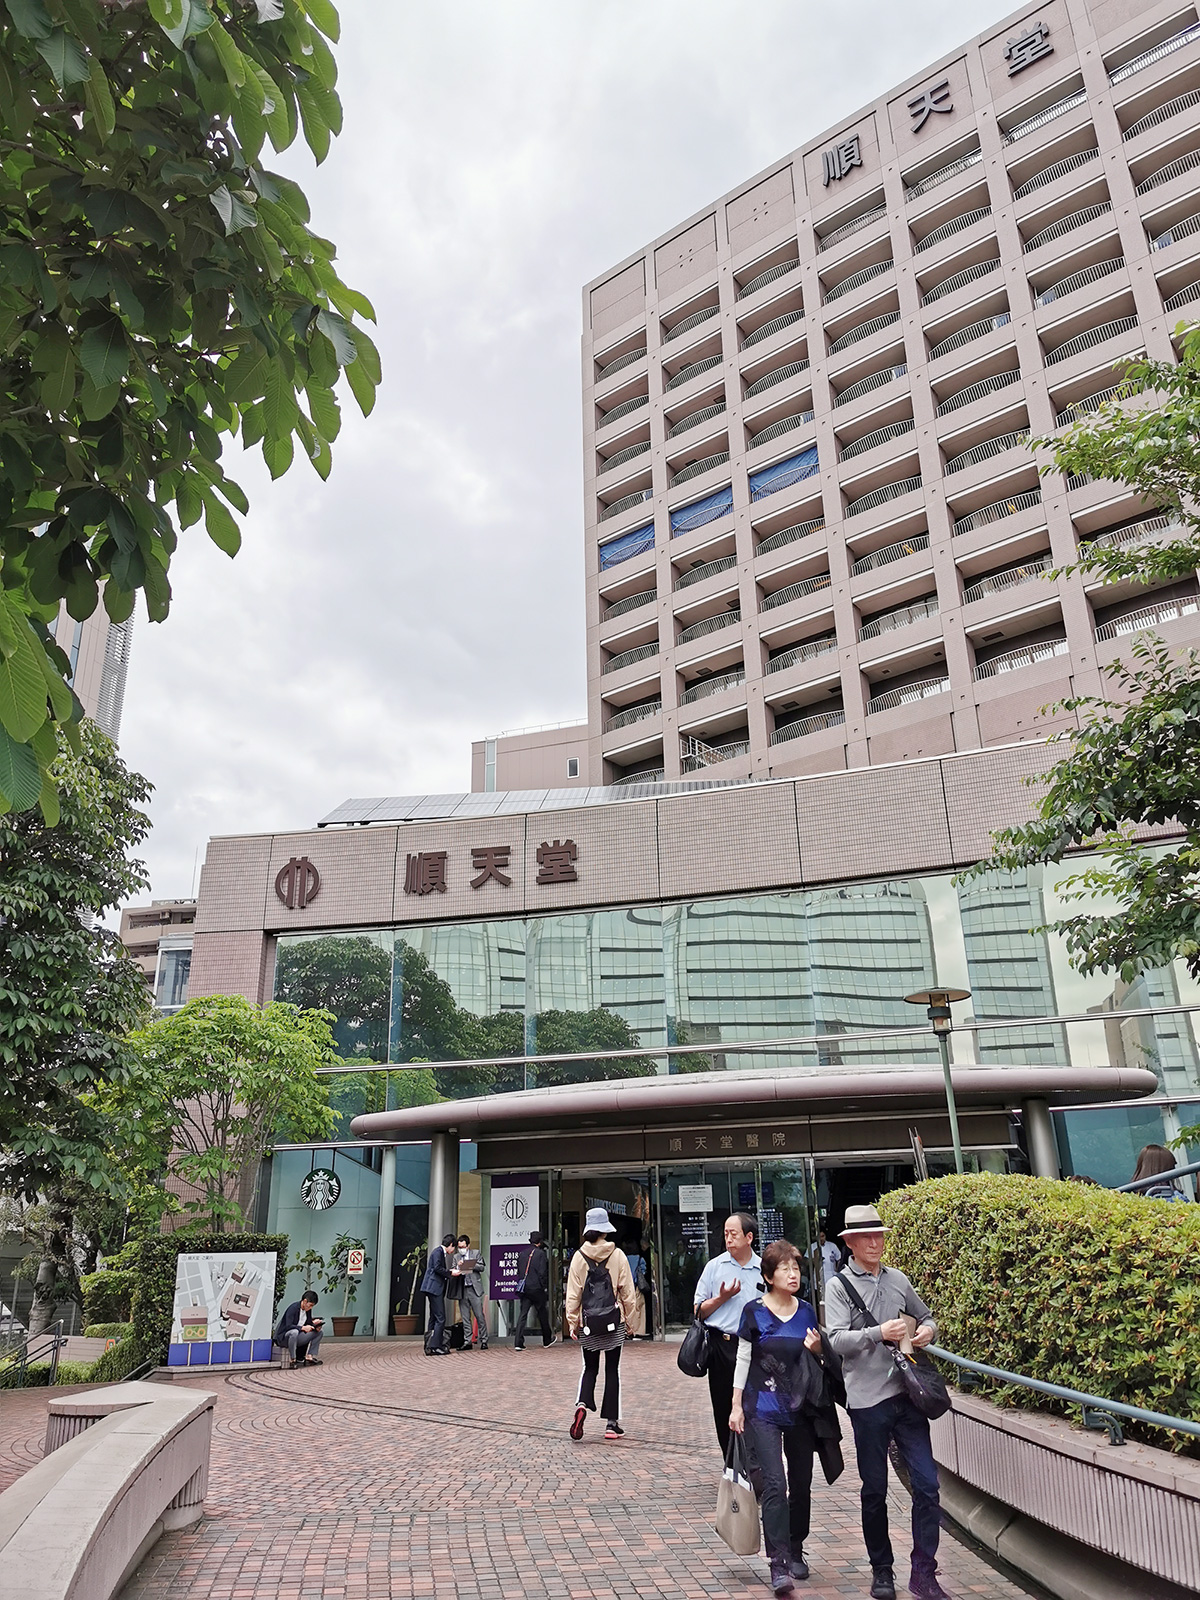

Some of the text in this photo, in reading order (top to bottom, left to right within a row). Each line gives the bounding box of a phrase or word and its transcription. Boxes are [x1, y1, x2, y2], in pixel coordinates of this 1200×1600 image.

[821, 21, 1055, 188] 順天堂
[403, 839, 579, 896] 順天堂
[669, 1132, 786, 1152] 順天堂醫院
